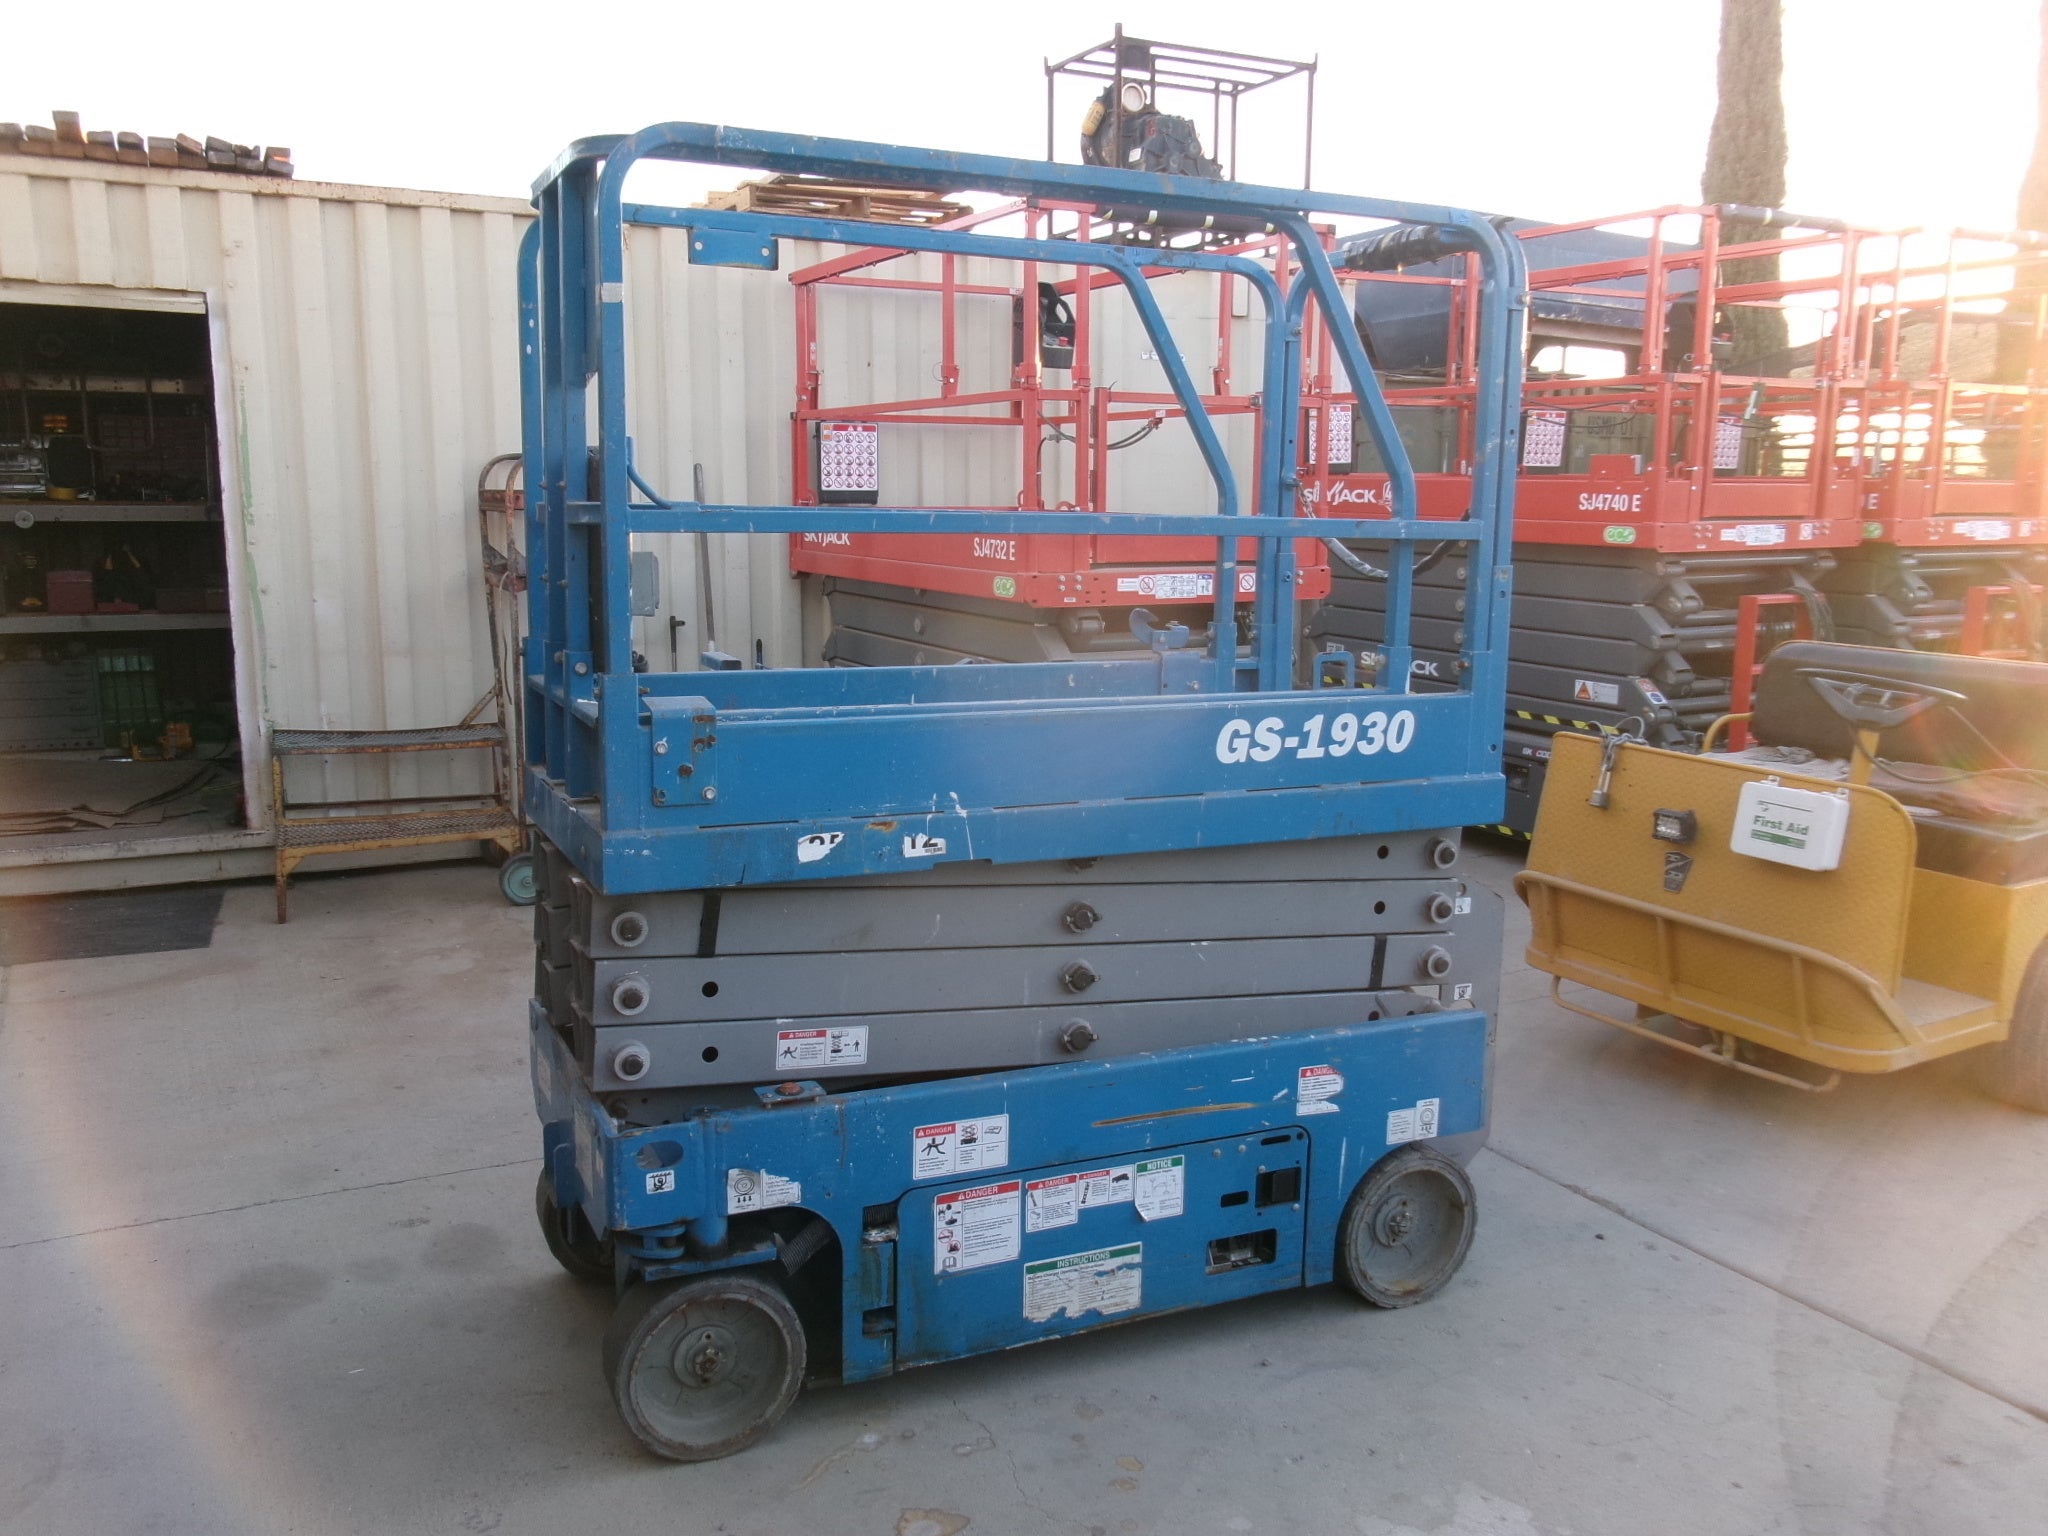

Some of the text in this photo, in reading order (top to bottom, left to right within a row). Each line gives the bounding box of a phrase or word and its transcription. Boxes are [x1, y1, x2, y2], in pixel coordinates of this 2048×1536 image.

[1579, 493, 1641, 512] SJ4740 E
[973, 537, 1016, 561] SJ4732 E
[1215, 709, 1415, 764] GS-1930
[1753, 814, 1809, 836] First Aid
[1312, 1067, 1339, 1077] DANG
[925, 1126, 952, 1136] DANGER
[1146, 1159, 1172, 1171] NOTICE
[1045, 1177, 1070, 1188] DANGER
[965, 1186, 998, 1199] DANGER
[1057, 1251, 1110, 1268] INSTRUCTIONS
